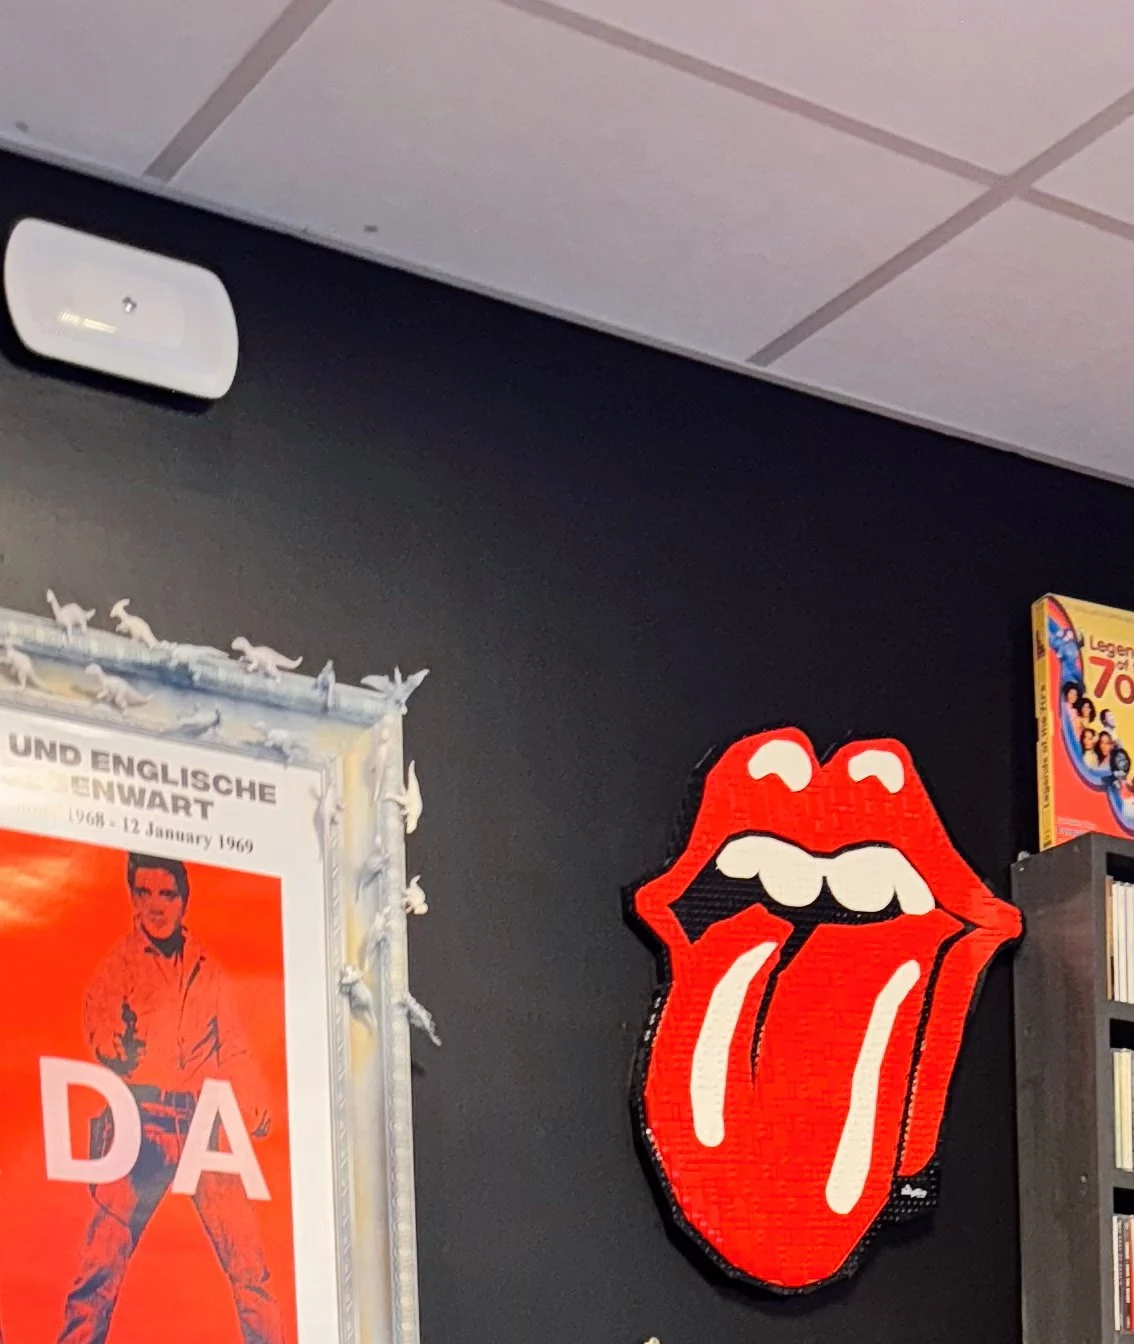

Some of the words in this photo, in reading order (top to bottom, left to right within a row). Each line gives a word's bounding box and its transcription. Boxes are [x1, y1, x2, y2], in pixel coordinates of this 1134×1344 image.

[8, 732, 82, 767] UND
[91, 749, 278, 805] ENGLISCHE
[145, 822, 212, 852] January
[218, 834, 255, 855] 1969
